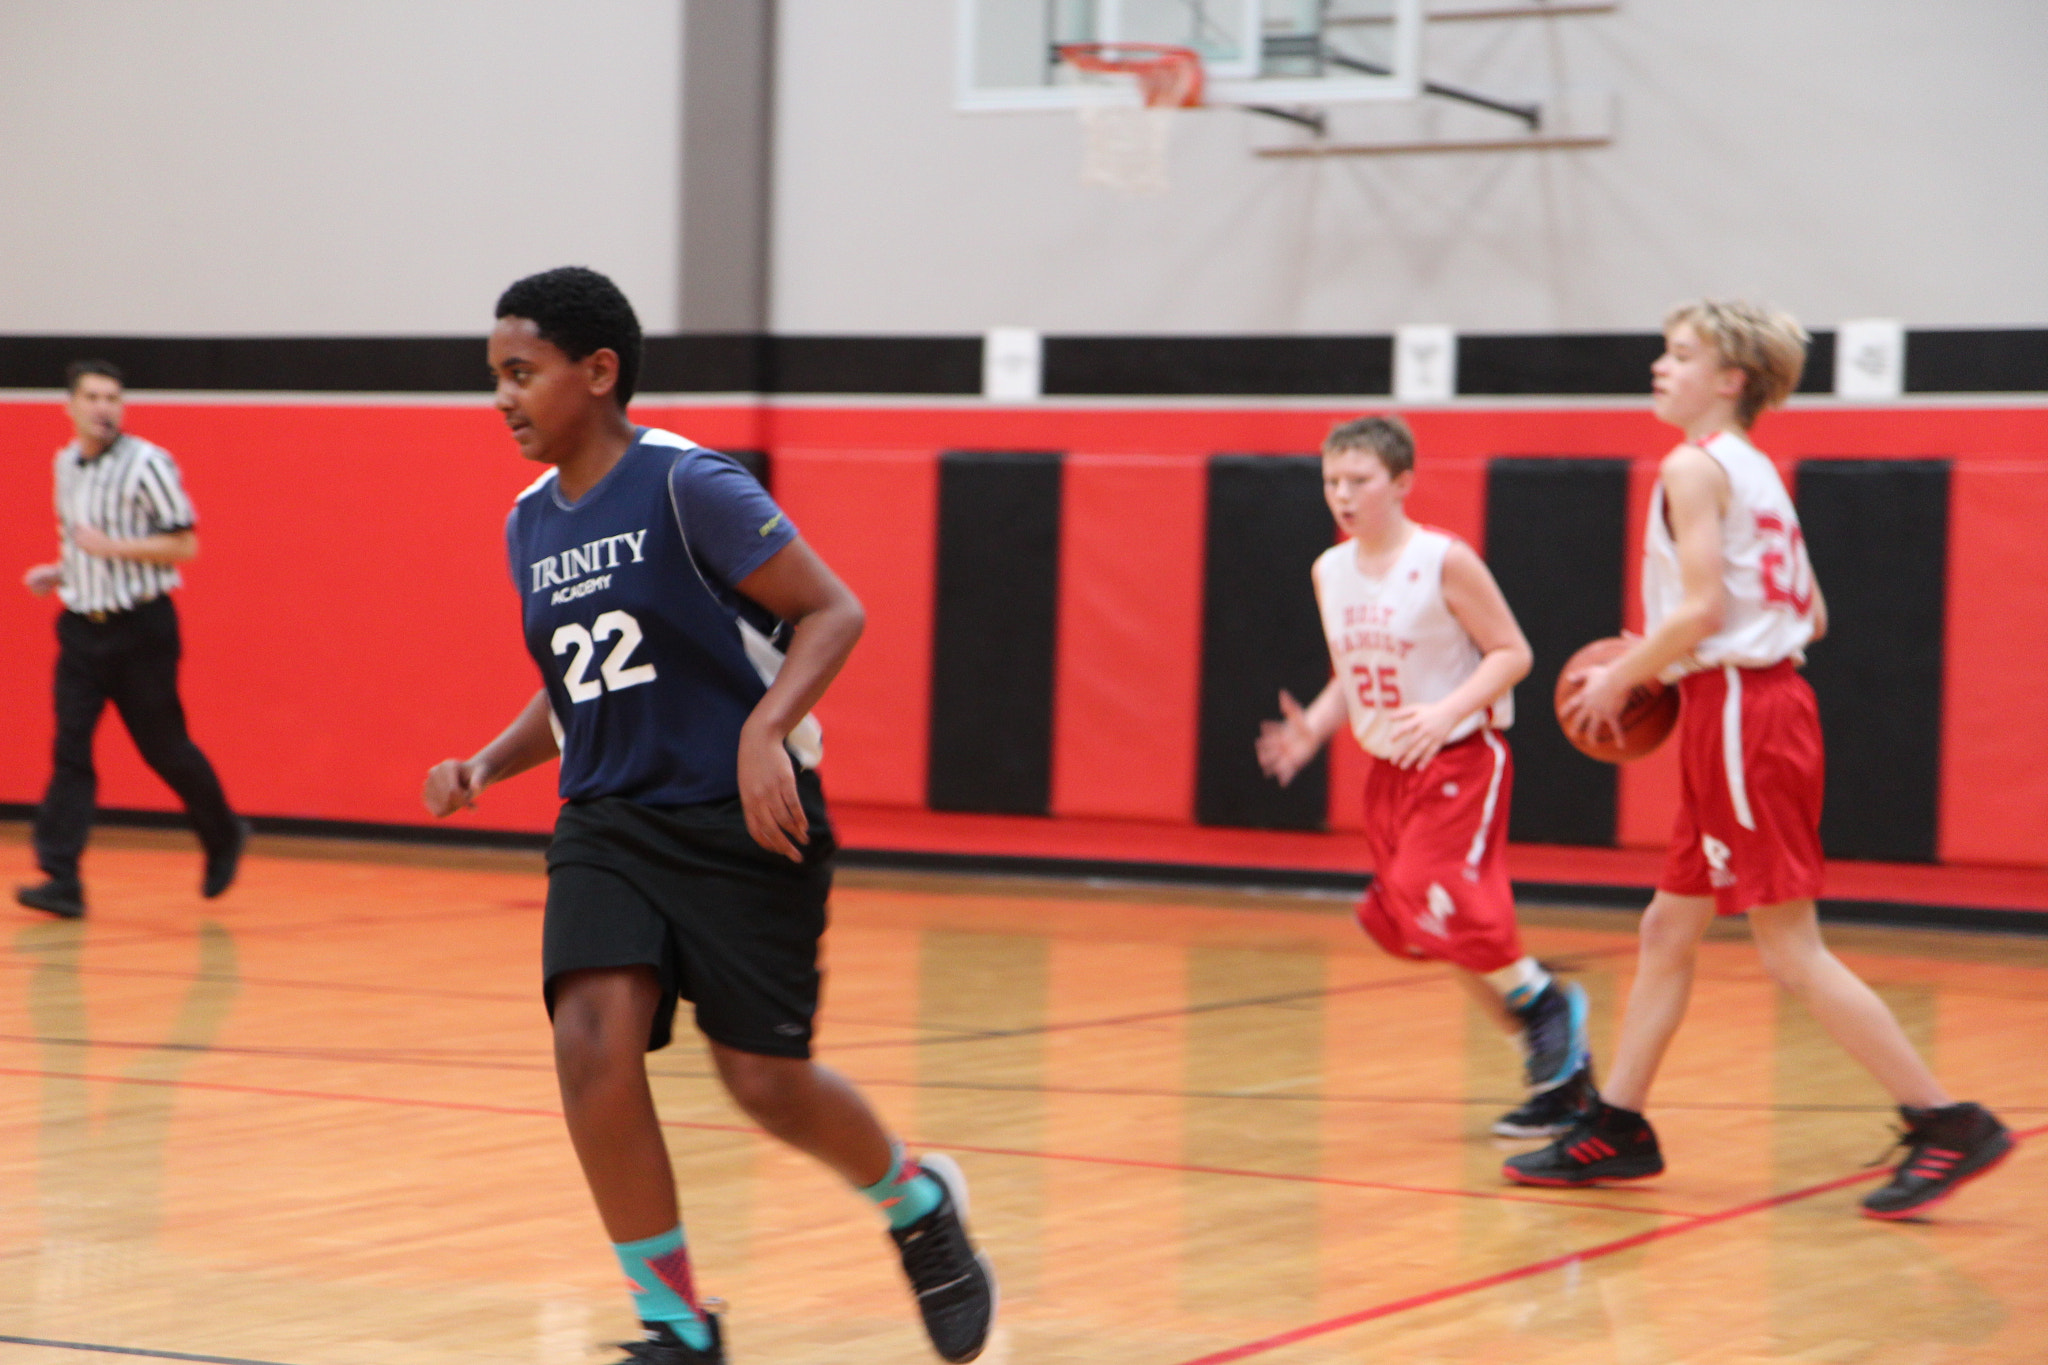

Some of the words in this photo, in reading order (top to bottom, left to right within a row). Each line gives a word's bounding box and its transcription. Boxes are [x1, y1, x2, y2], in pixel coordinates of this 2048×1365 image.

[530, 528, 647, 593] TRINITY
[551, 573, 612, 606] ACADEMY
[1344, 605, 1393, 628] HOLY
[551, 609, 657, 704] 22
[1351, 664, 1401, 709] 25
